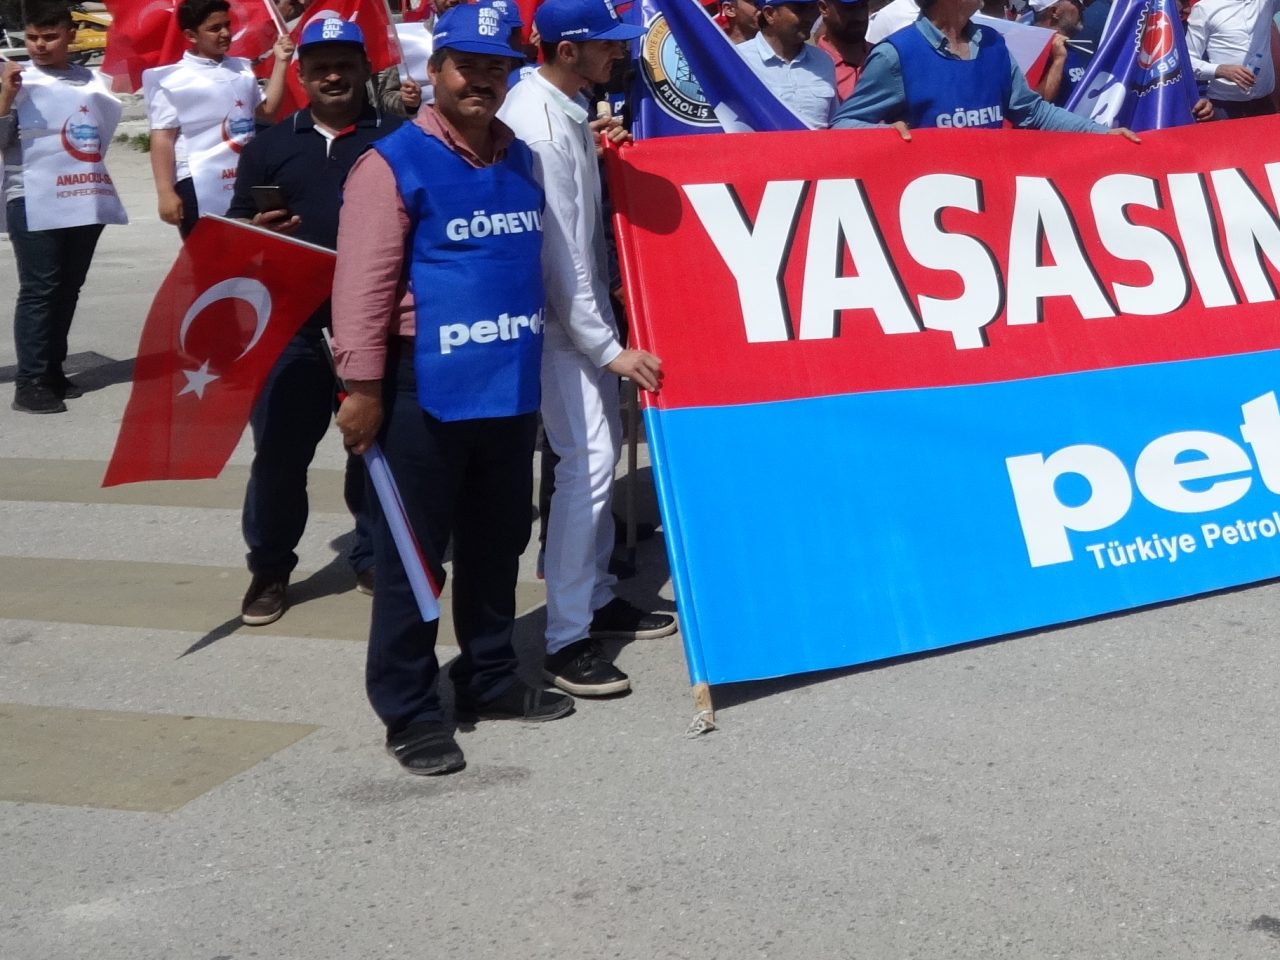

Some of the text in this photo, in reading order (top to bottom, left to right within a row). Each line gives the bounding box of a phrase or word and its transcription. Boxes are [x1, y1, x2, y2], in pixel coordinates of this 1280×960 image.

[660, 84, 709, 119] PETROL-İŞ
[936, 105, 1004, 129] GÖREVL
[1086, 533, 1196, 569] Türkiye
